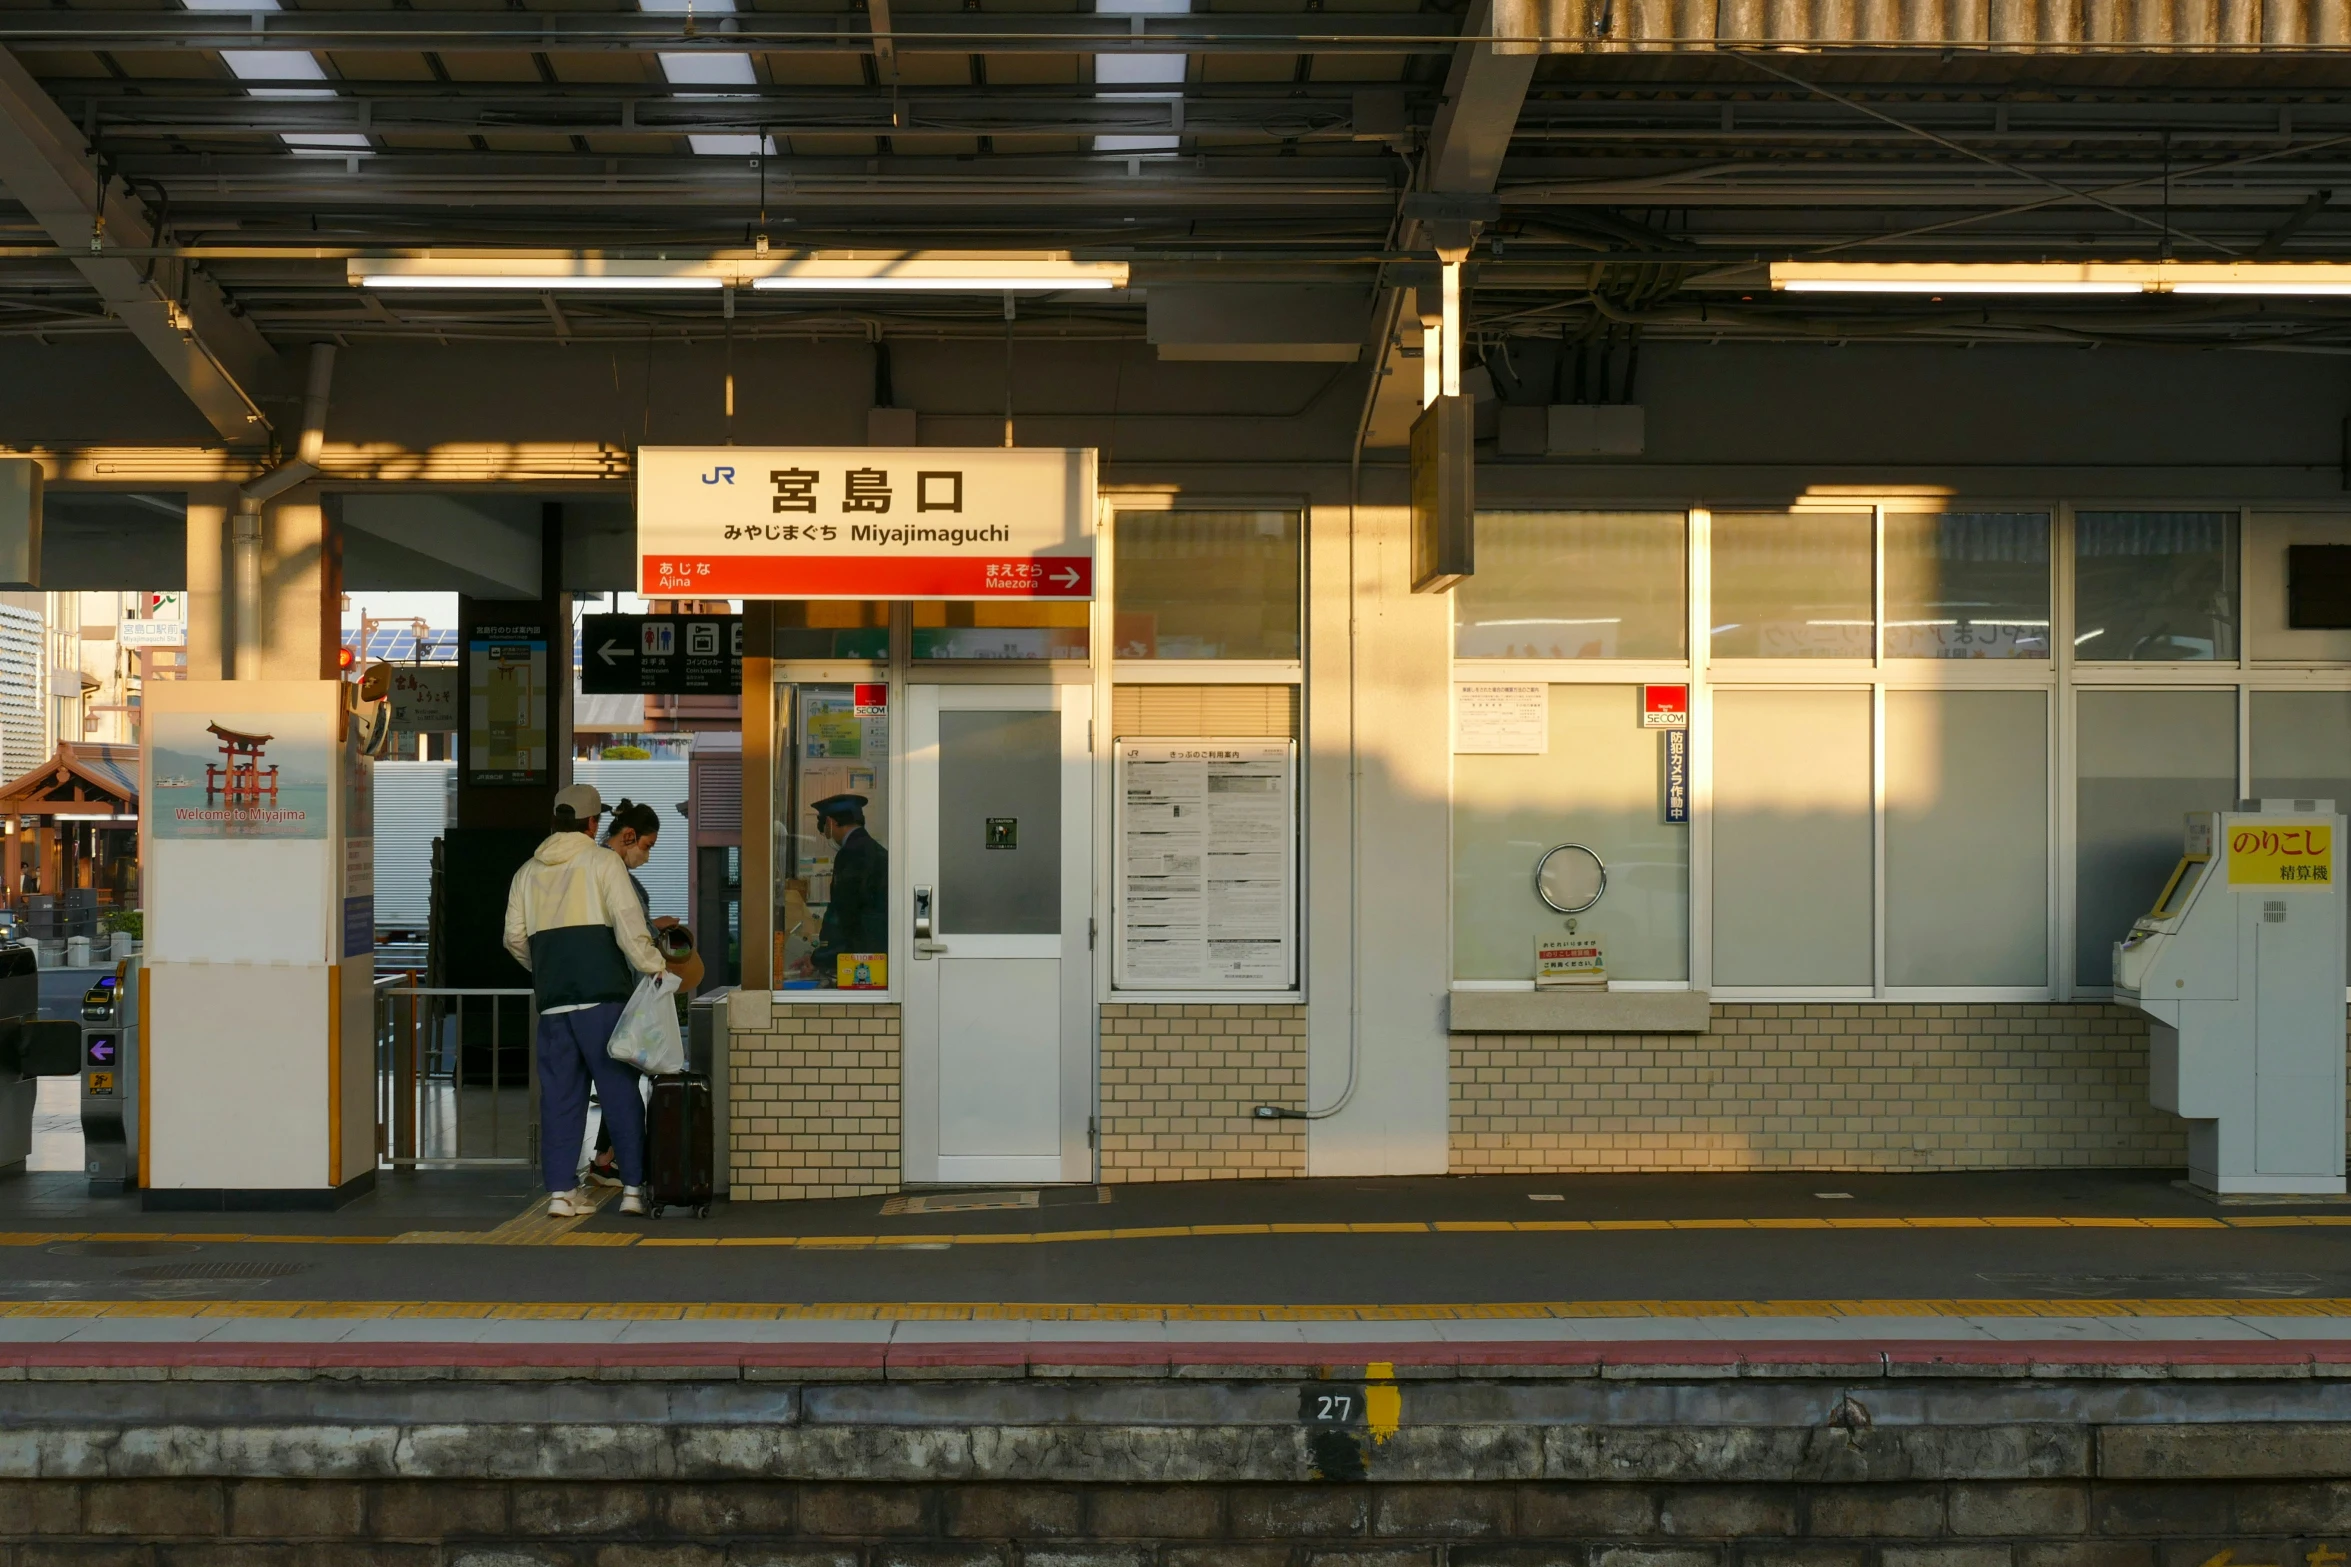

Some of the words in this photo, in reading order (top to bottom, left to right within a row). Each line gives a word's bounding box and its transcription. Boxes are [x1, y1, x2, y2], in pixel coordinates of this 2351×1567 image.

[701, 466, 736, 485] JR
[769, 466, 963, 514] 宮島口
[723, 524, 837, 541] みやじまぐち
[850, 523, 1009, 546] Miyajimaguchi
[659, 561, 711, 576] あじな
[985, 562, 1043, 577] まえぞら
[659, 575, 691, 588] Ajina
[985, 577, 1039, 588] Maezora
[124, 623, 178, 635] 宮島口駅前
[686, 658, 724, 666] コインロッカー
[416, 691, 450, 703] ようこそ
[856, 706, 885, 714] SECOM
[1647, 713, 1684, 723] SECOM
[1169, 751, 1240, 759] きっぷのご利用案内
[1670, 731, 1683, 820] 防犯カメラ作動中
[175, 808, 231, 820] Welcome
[234, 809, 246, 820] to
[250, 808, 306, 823] Miyajima
[2233, 829, 2327, 857] のりこし
[2279, 865, 2328, 881] 精算機
[1317, 1395, 1352, 1422] 27
